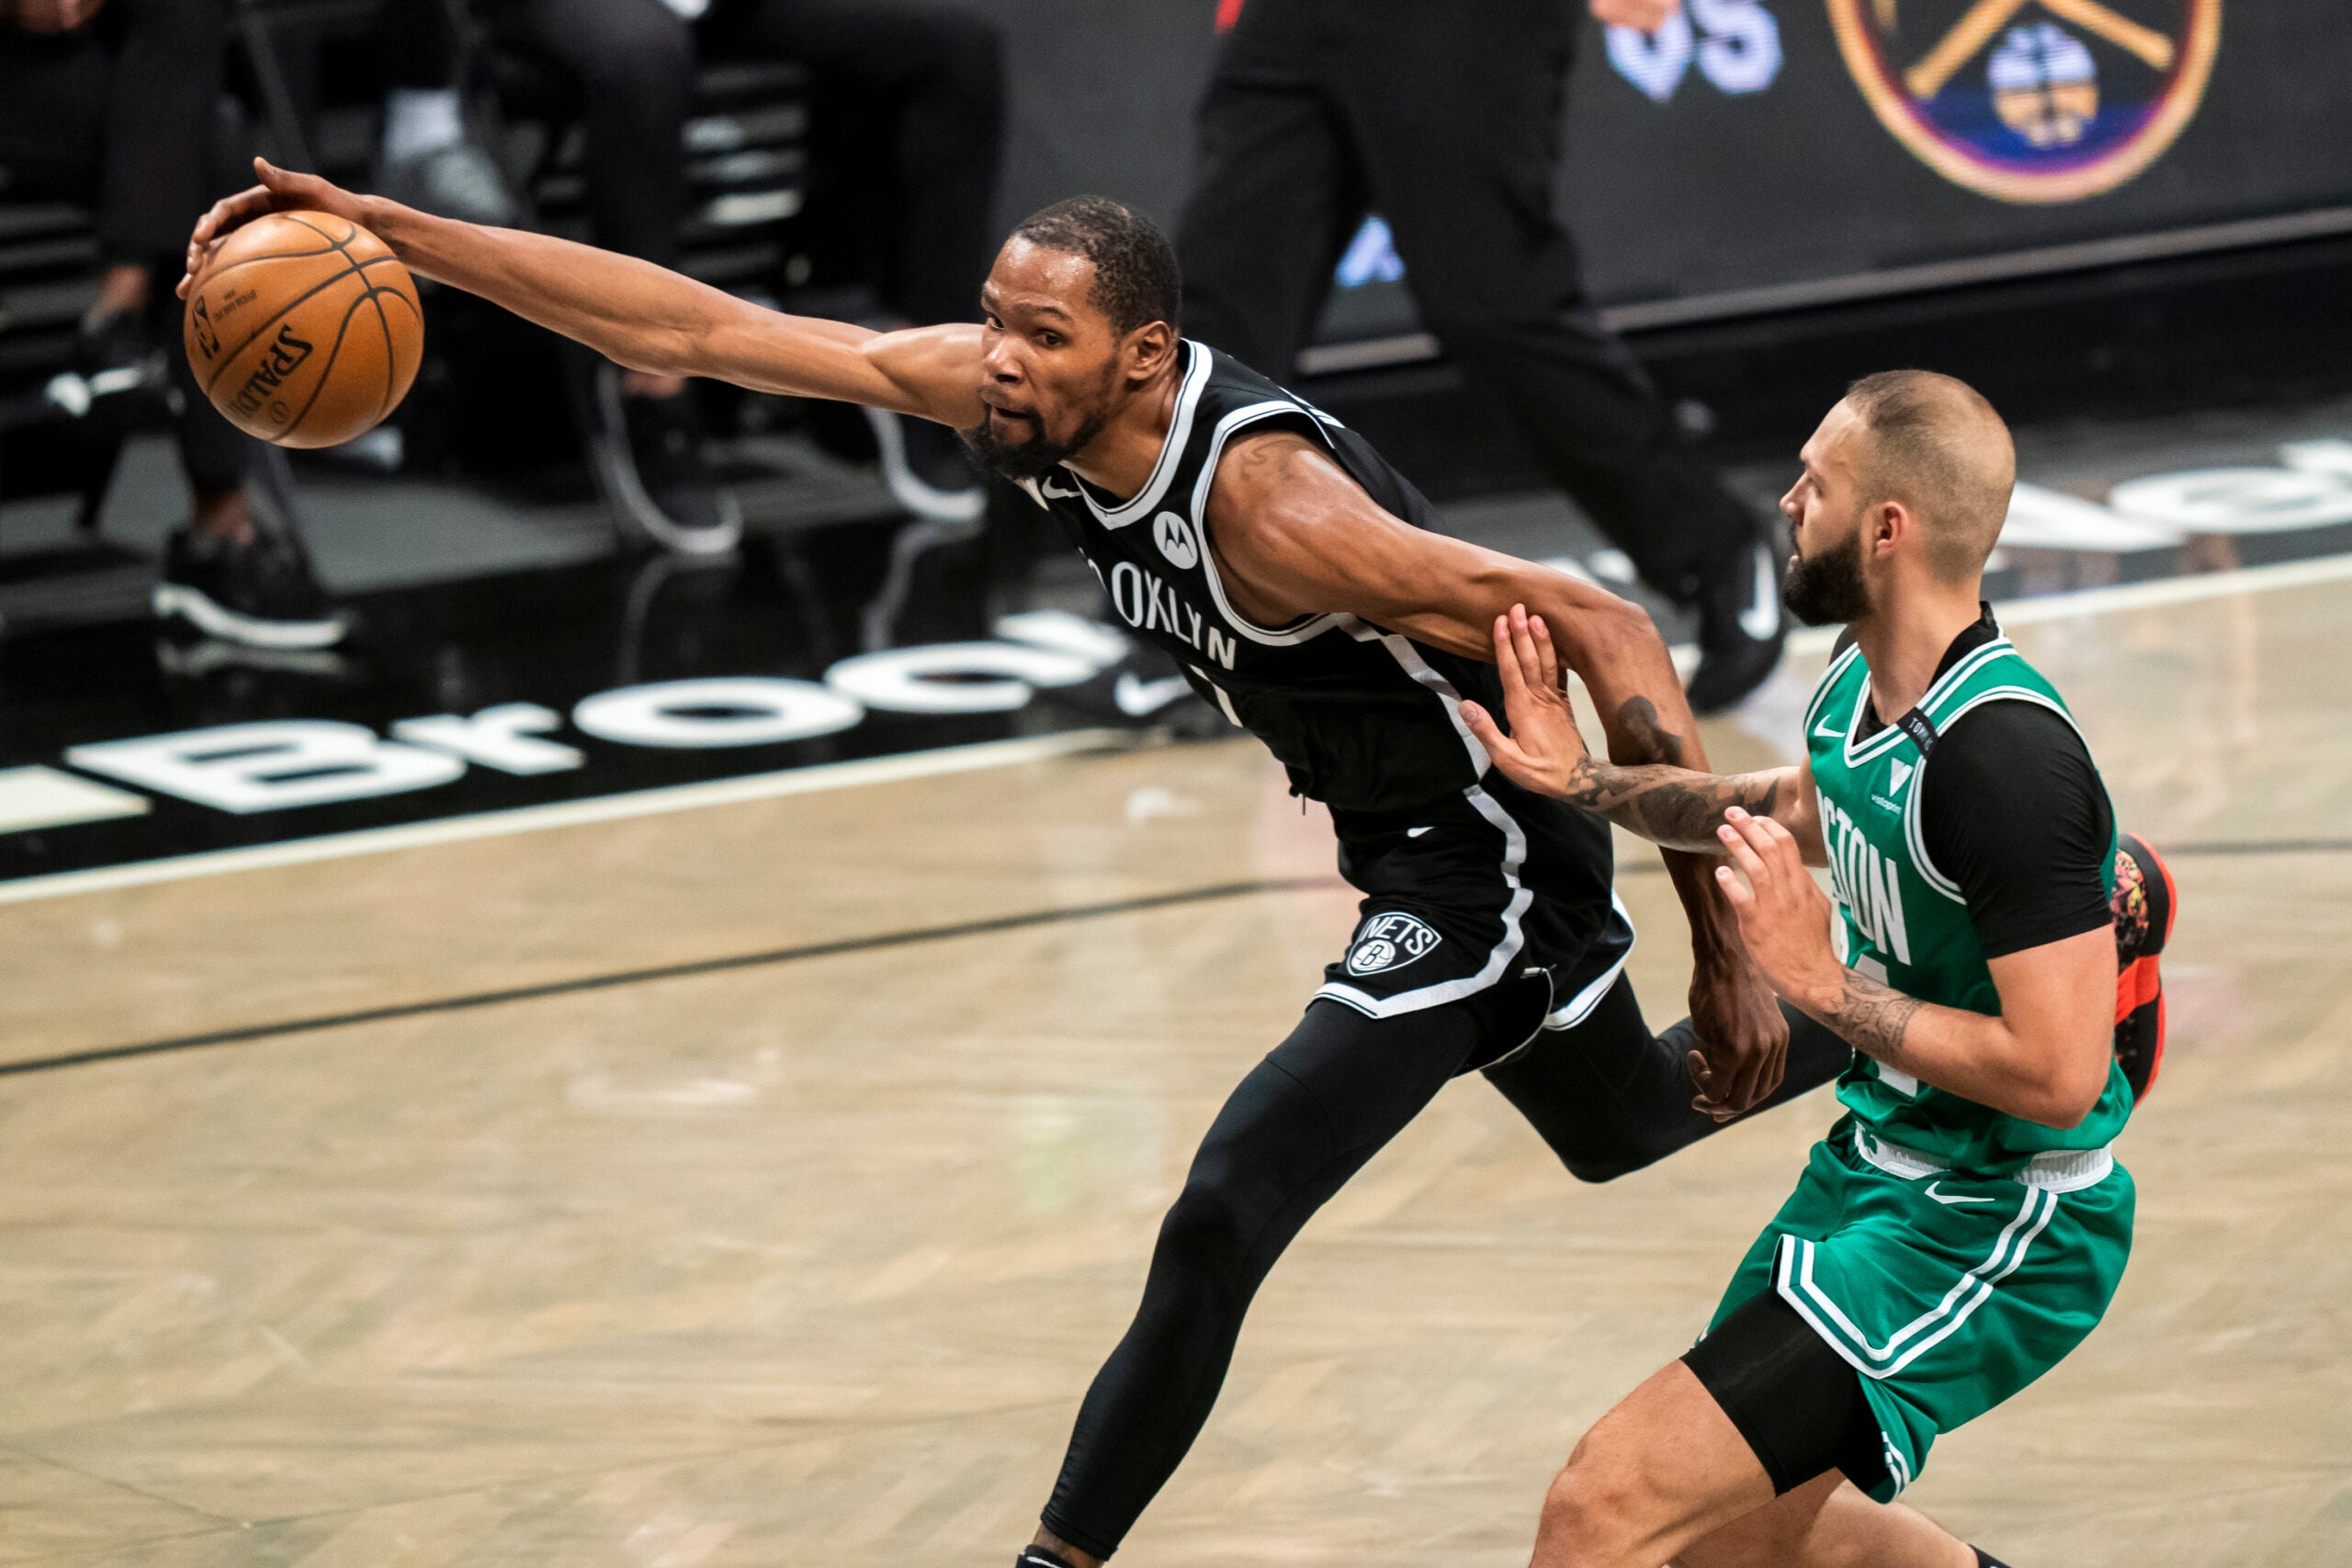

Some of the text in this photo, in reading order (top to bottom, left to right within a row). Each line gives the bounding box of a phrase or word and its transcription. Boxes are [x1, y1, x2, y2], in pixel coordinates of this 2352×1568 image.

[229, 323, 313, 419] SPALDI
[1088, 558, 1237, 671] OKLYN
[1815, 785, 1912, 966] STON
[1360, 916, 1434, 955] NETS
[1360, 943, 1384, 966] B
